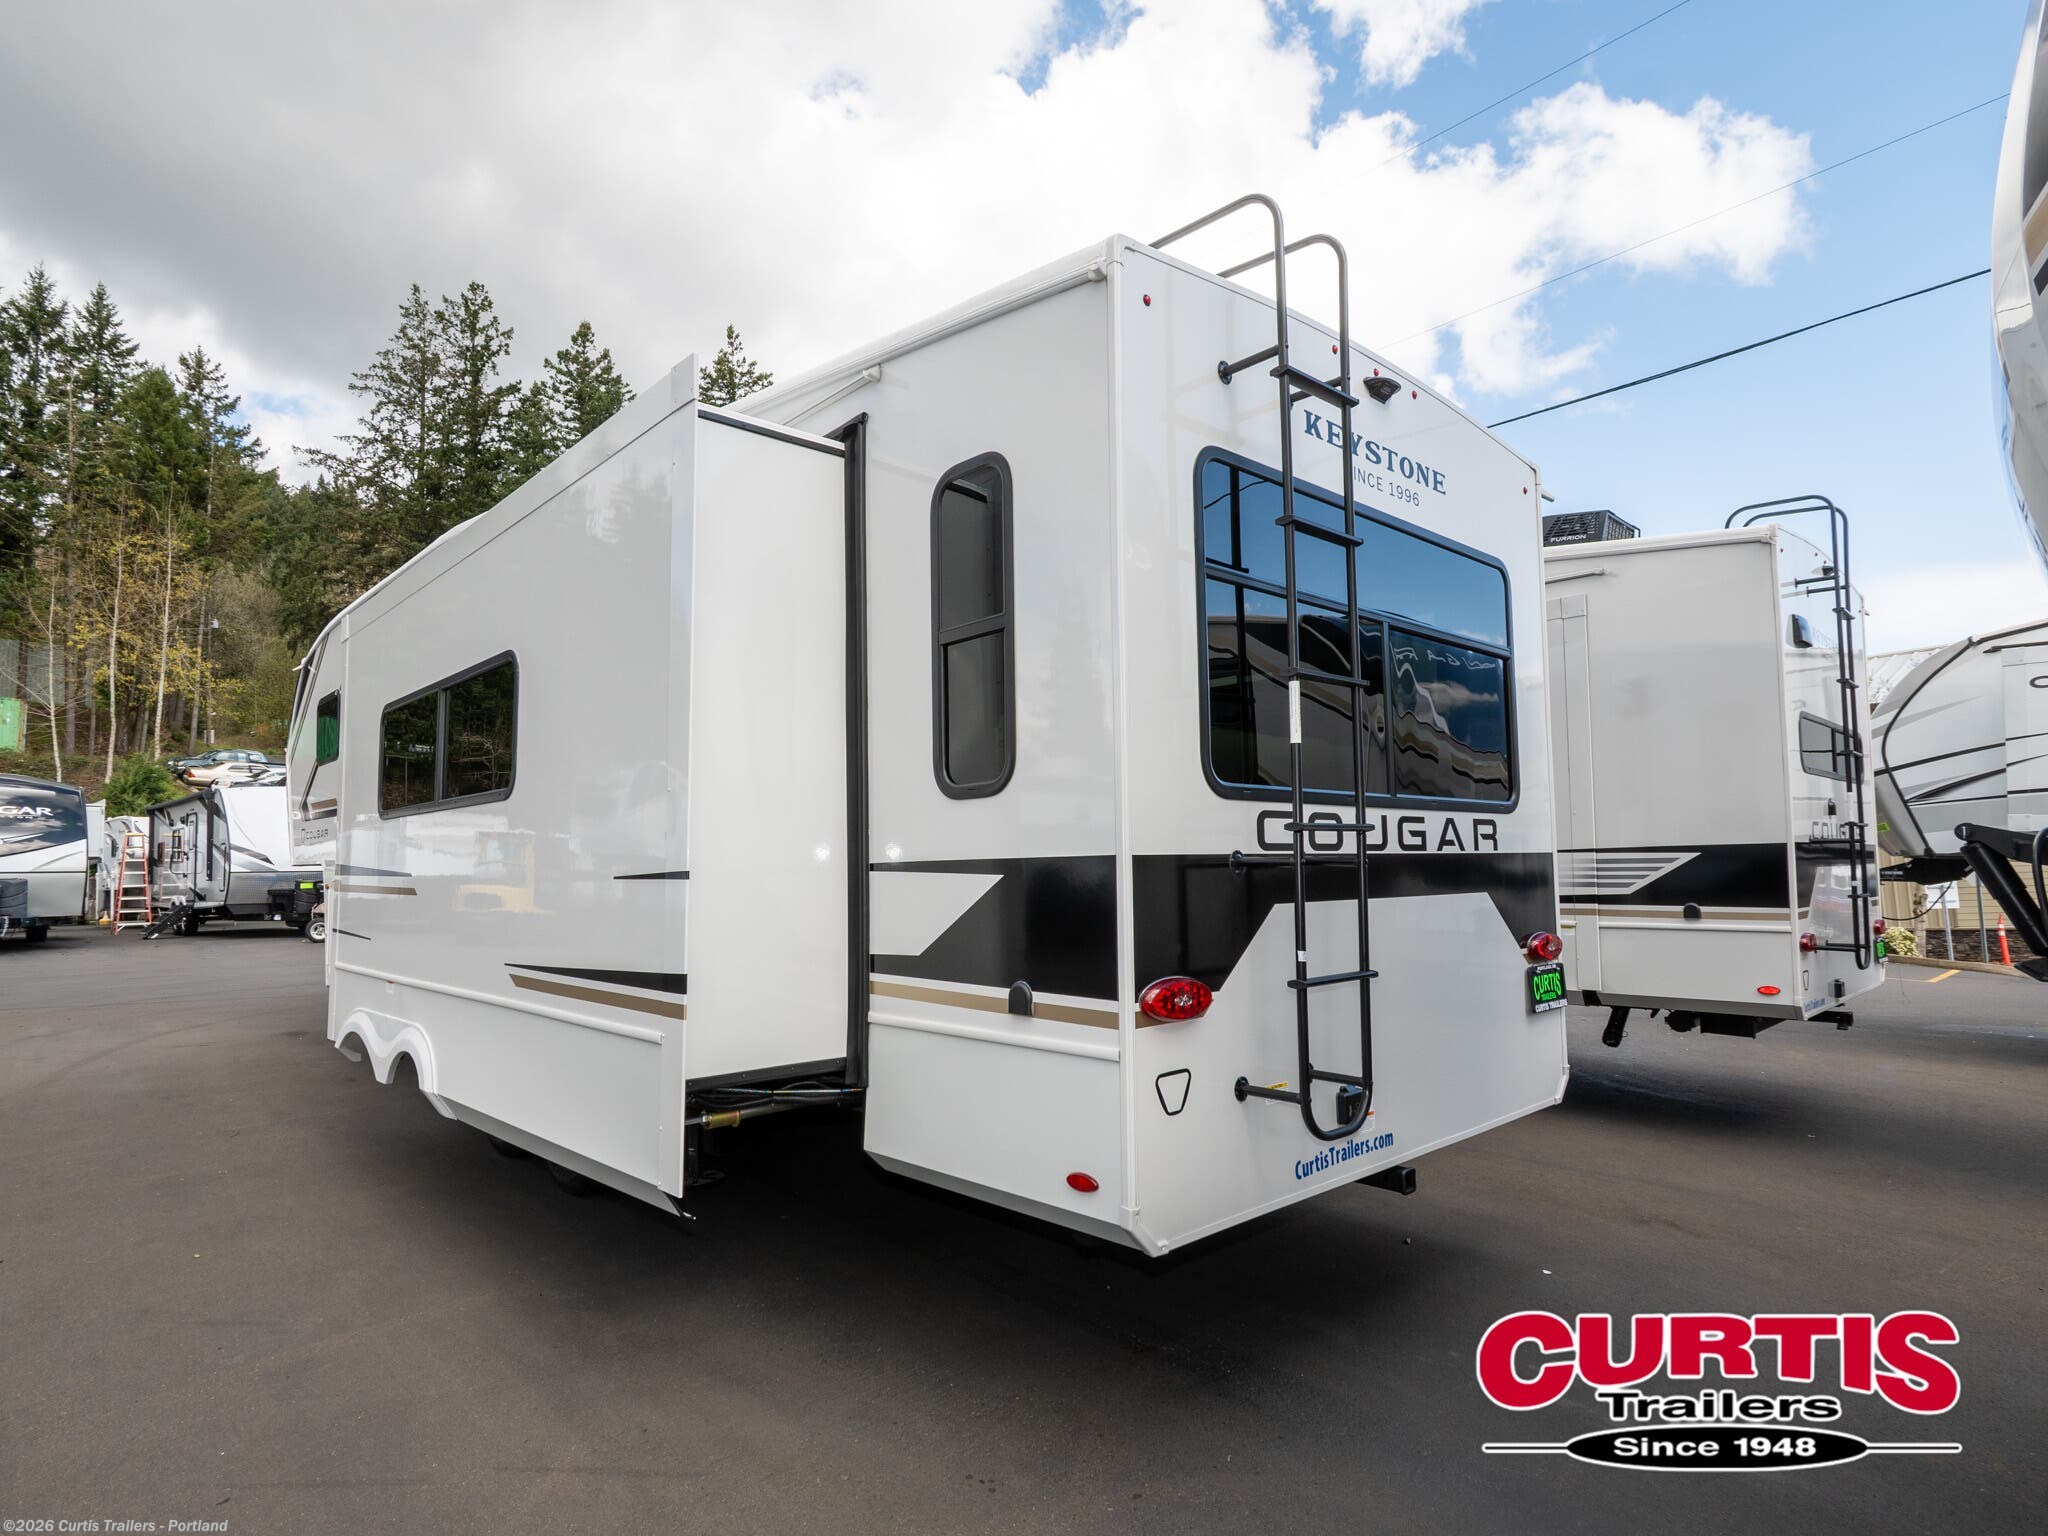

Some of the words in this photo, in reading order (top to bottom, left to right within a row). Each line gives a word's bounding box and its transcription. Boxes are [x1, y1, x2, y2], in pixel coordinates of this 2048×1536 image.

[1304, 409, 1447, 495] KEYSTONE
[1353, 466, 1384, 492] INCE
[1388, 482, 1420, 507] 1996
[1550, 534, 1587, 543] FURRION
[1256, 810, 1499, 852] COUGAR
[1533, 972, 1562, 1000] CURTIS
[1294, 1132, 1394, 1180] CurtisTrailers.com
